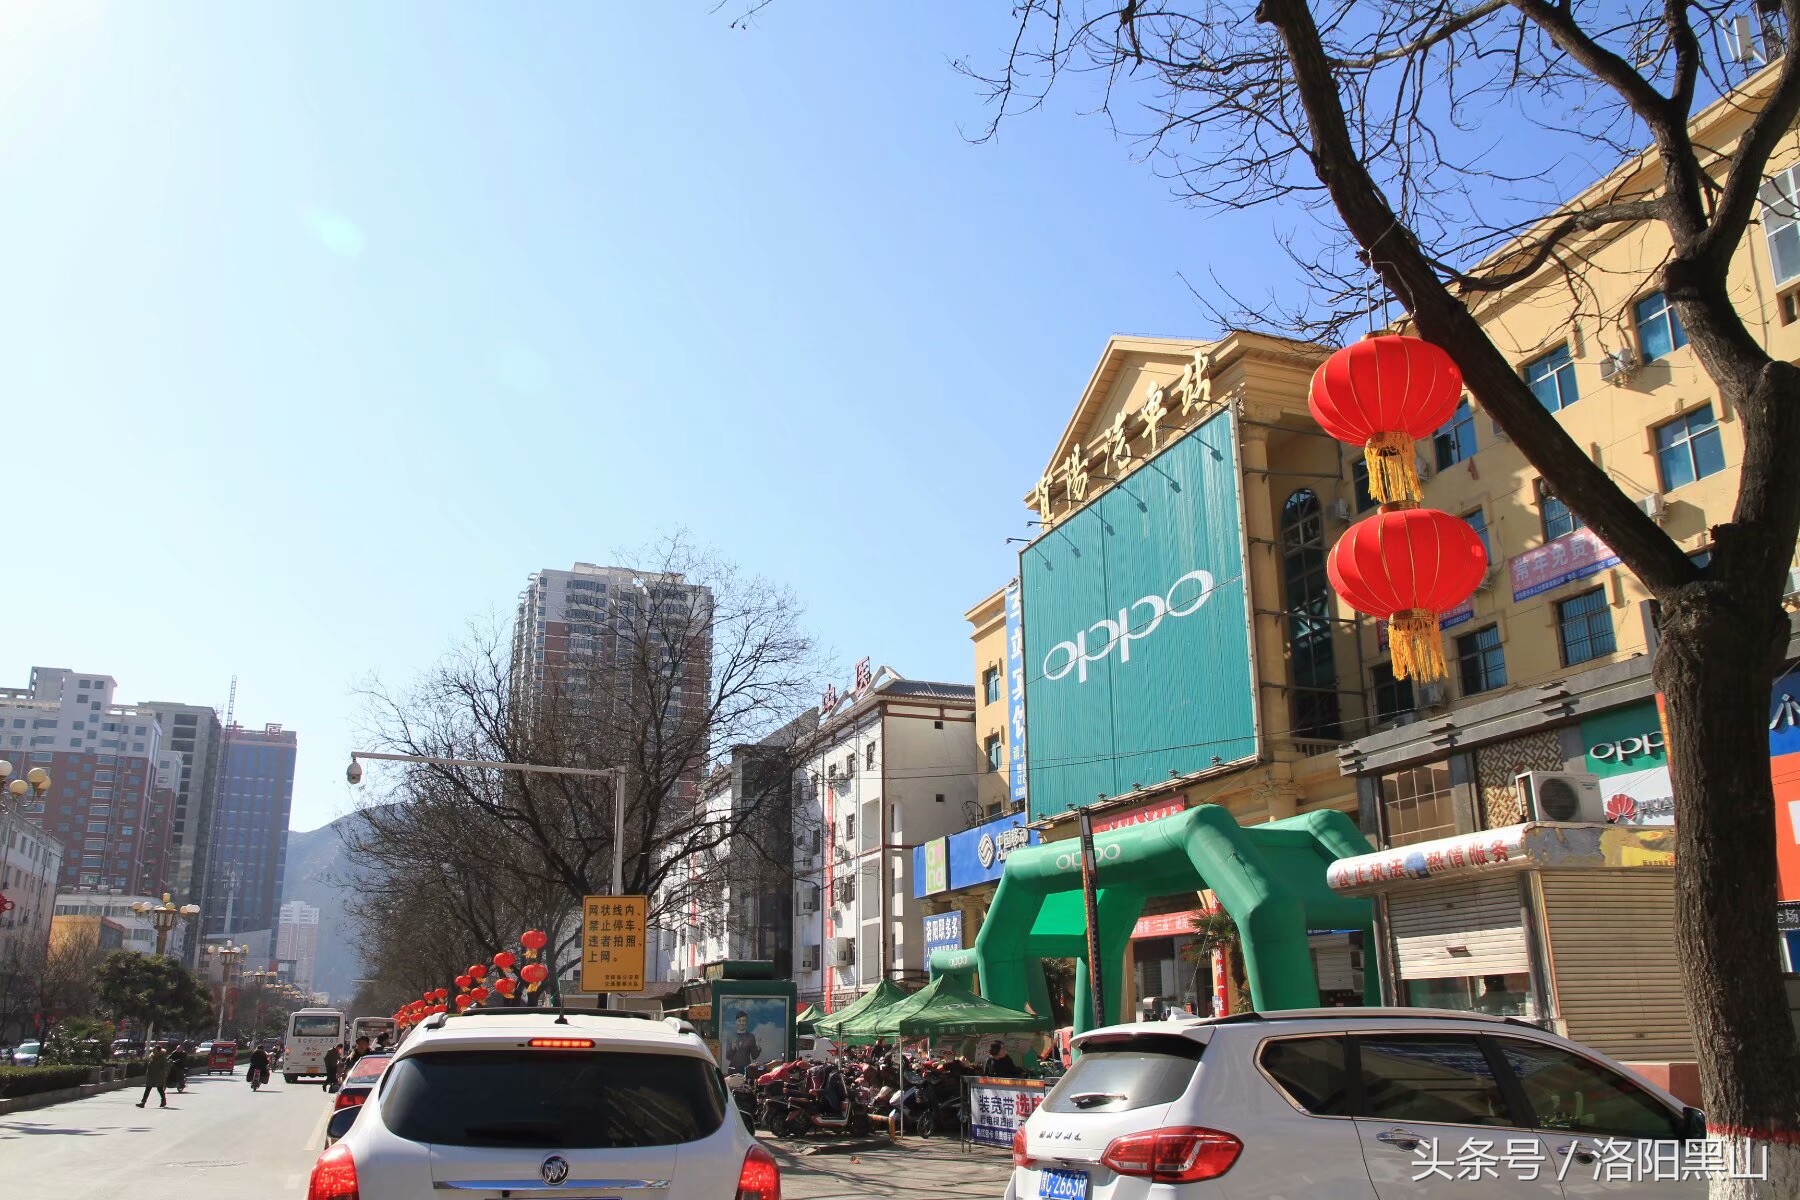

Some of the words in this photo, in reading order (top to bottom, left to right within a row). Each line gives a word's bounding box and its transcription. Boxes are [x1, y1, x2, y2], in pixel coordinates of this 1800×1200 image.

[1043, 569, 1214, 684] oppo
[1590, 731, 1664, 761] opp
[1640, 796, 1673, 812] HUA
[995, 828, 1029, 850] 中国移动
[1336, 858, 1405, 888] 公正执法
[1426, 840, 1509, 872] 热情服务
[588, 951, 618, 963] 上网。
